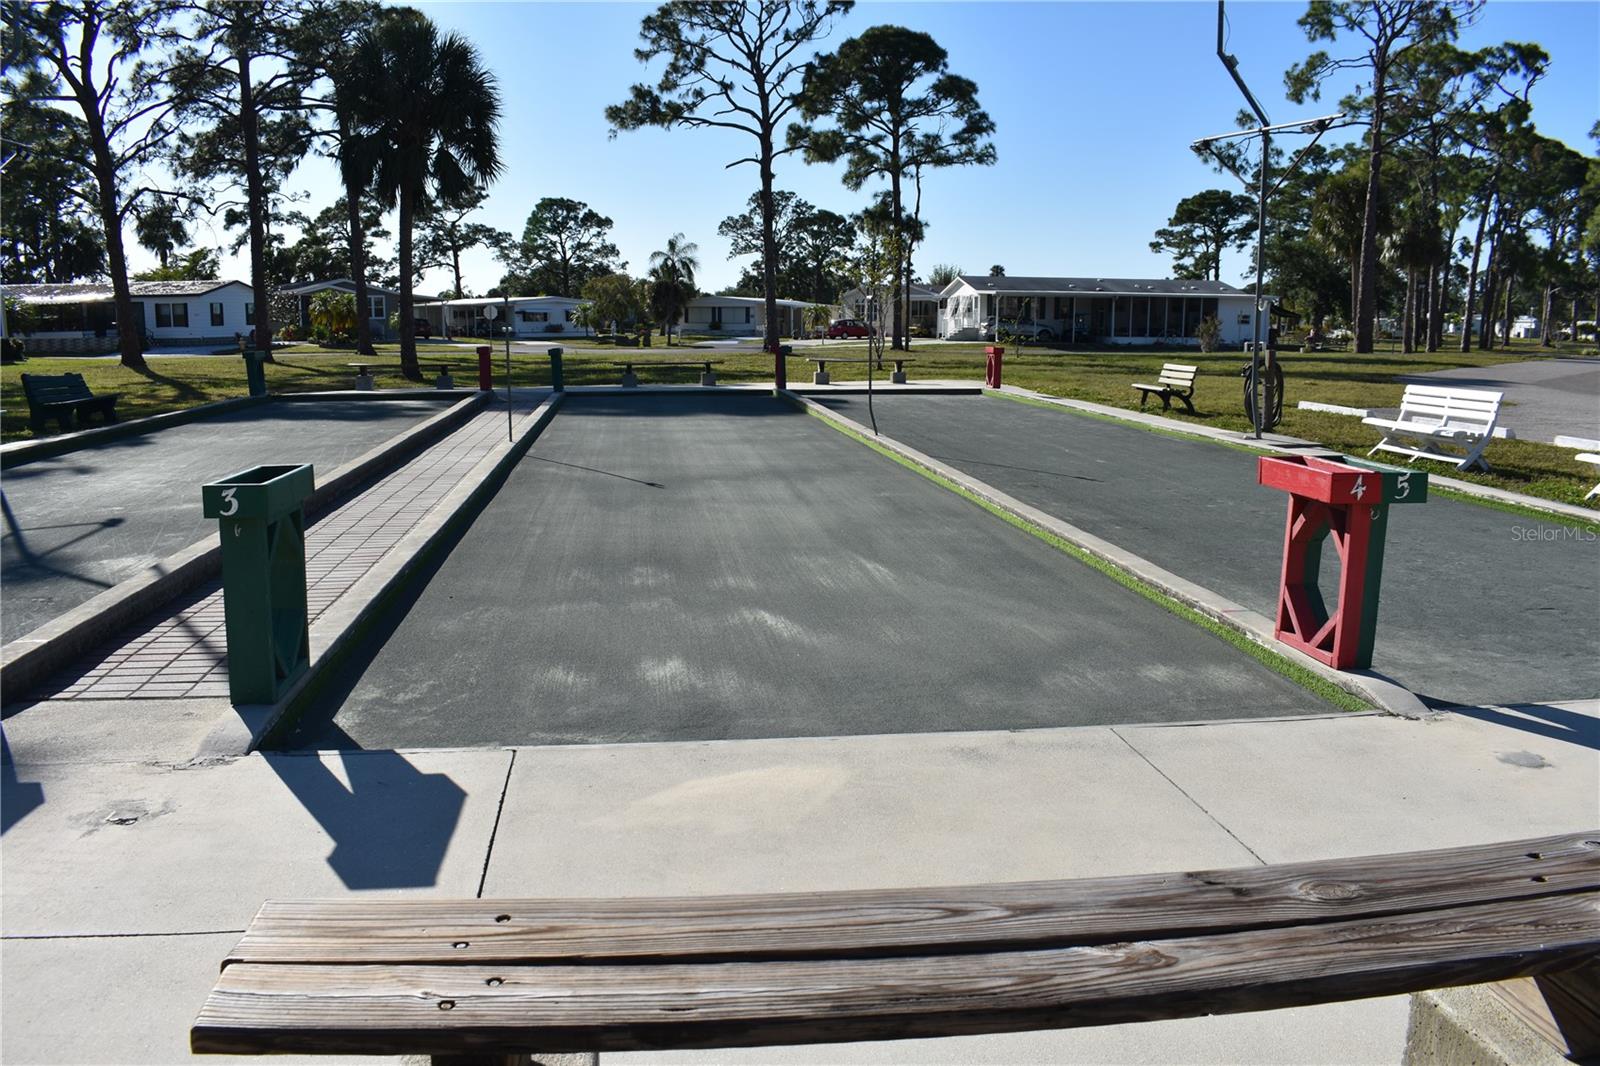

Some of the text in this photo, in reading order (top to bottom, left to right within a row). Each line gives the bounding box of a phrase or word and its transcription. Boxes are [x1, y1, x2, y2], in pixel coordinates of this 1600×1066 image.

[1350, 475, 1367, 501] 4
[1394, 472, 1411, 499] 5
[219, 487, 239, 516] 3
